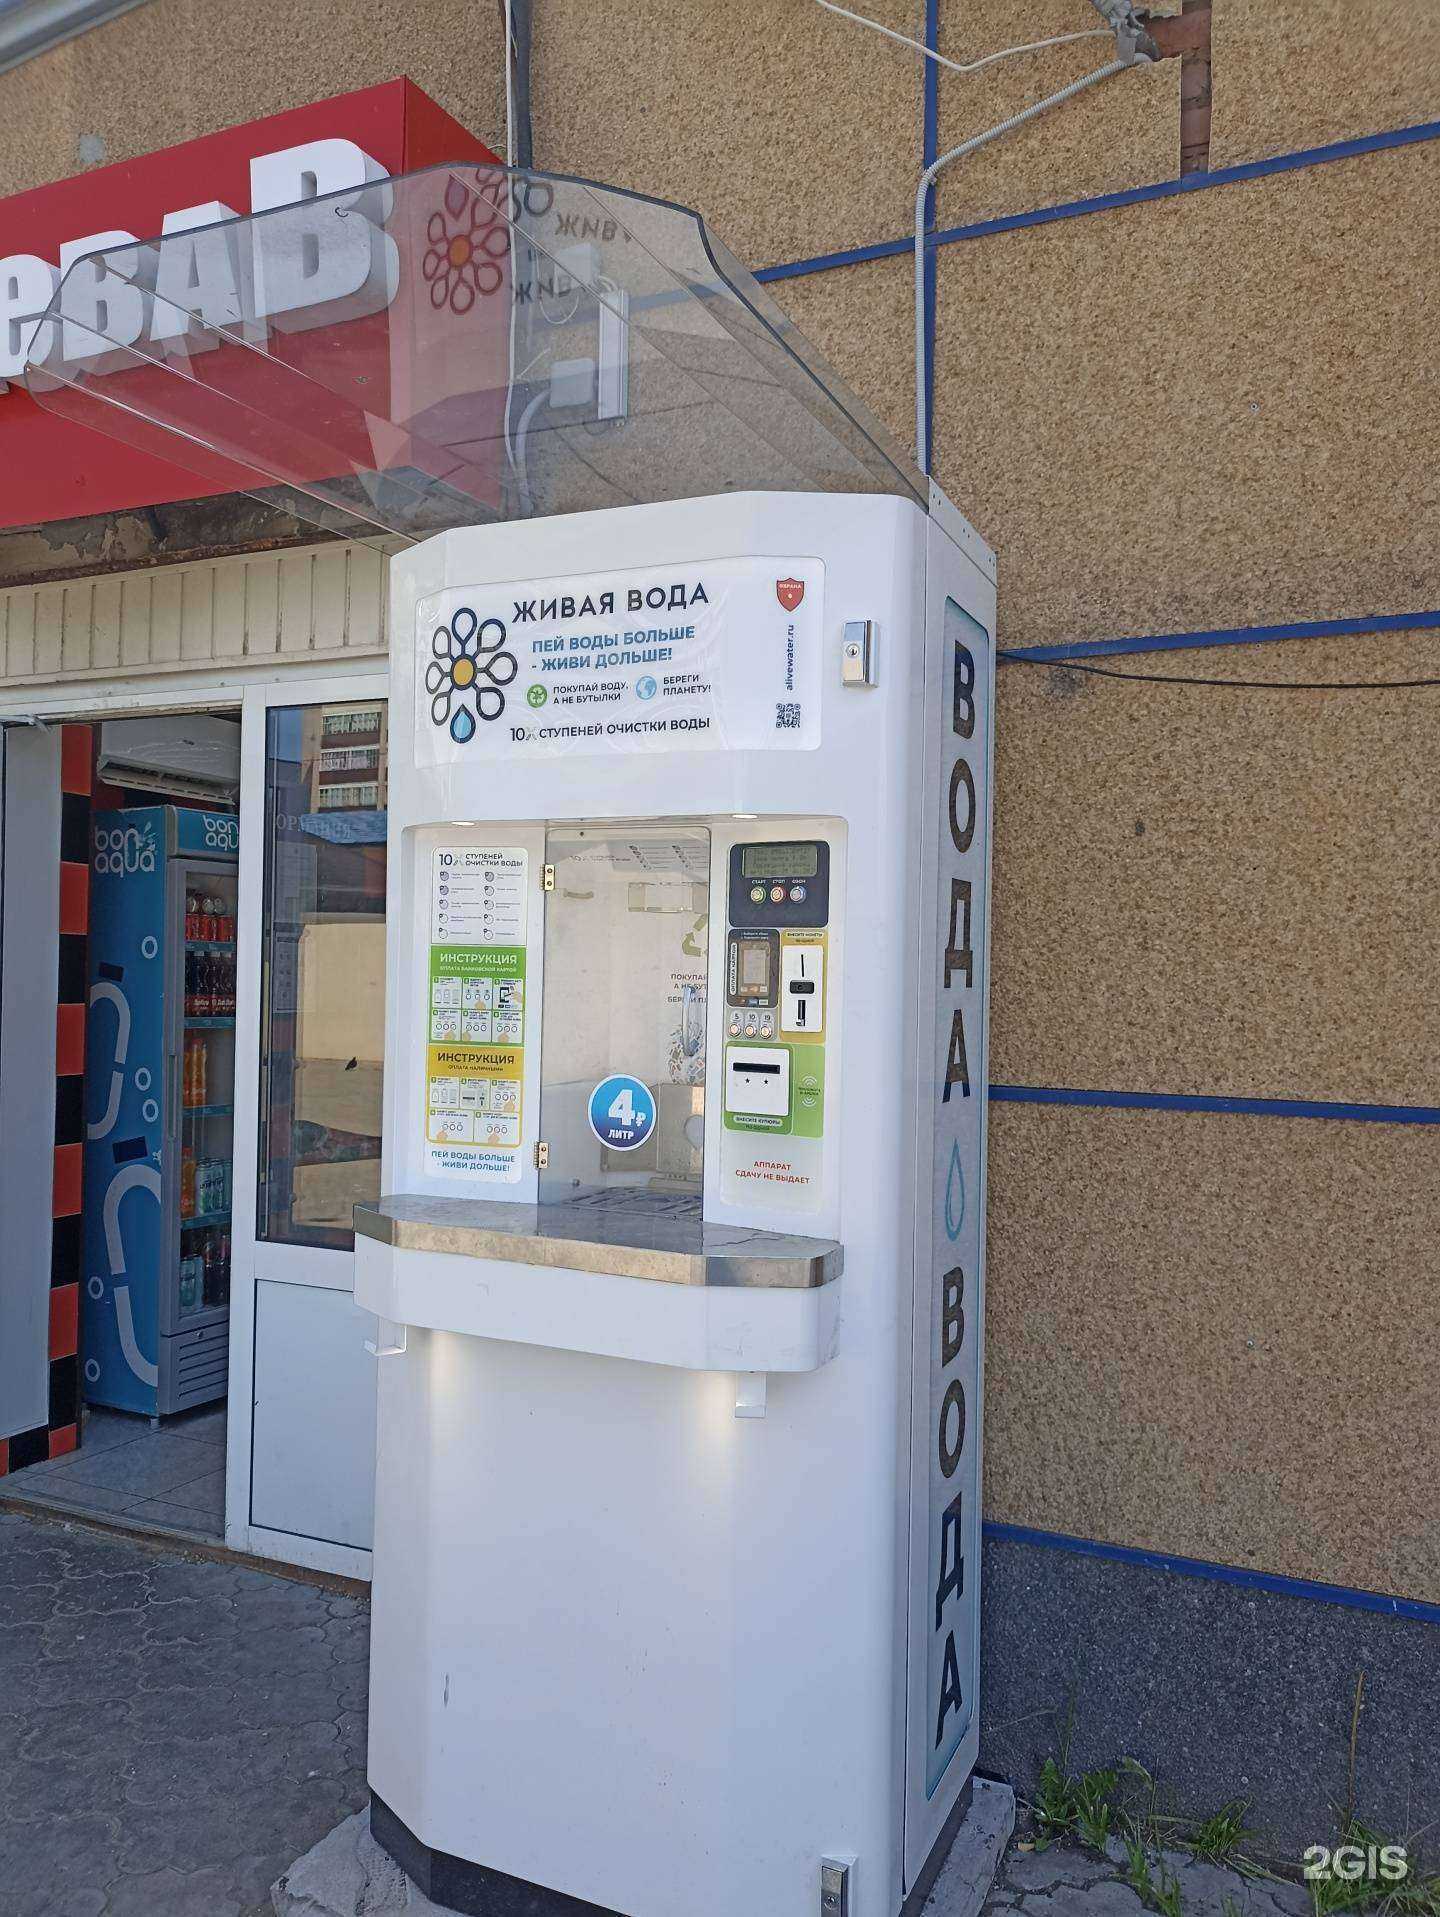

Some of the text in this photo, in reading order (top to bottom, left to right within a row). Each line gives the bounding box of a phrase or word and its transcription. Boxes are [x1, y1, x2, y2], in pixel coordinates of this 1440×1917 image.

[512, 582, 709, 623] ЖИВАЯ ВОДА
[532, 625, 696, 653] ПЕЙ ВОДЫ БОЛЬШЕ
[541, 656, 590, 671] ЖИВИ
[595, 647, 673, 669] ДОЛЬШЕ!
[785, 624, 795, 691] alivewater.ru
[663, 674, 700, 684] БЕРЕГИ
[553, 681, 629, 694] ПОКУПАЙ ВОДУ,
[663, 685, 711, 696] ПЛАНЕТУ!
[562, 696, 574, 704] НЕ
[576, 693, 621, 703] БУТЫЛКИ
[539, 723, 603, 738] СТУПЕНЕЙ
[607, 720, 666, 735] ОЧИСТКИ
[670, 718, 710, 731] ВОДЫ
[203, 814, 238, 833] bon
[95, 825, 140, 850] bon
[95, 850, 155, 878] aqua
[942, 640, 976, 1104] ВОДА
[440, 953, 517, 965] ИНСТРУКЦИЯ
[437, 1053, 515, 1065] ИНСТРУКЦИЯ
[608, 1129, 634, 1140] ЛИТР
[450, 1152, 476, 1161] ВОДЫ
[479, 1153, 515, 1162] БОЛЬШЕ
[442, 1161, 467, 1169] ЖИВИ
[470, 1162, 510, 1172] ДОЛЬШЕ!
[754, 1161, 791, 1170] АППАРАТ
[736, 1170, 810, 1184] СДАЧУ НЕ ВЫДАЕТ
[934, 1266, 966, 1751] ВОДА
